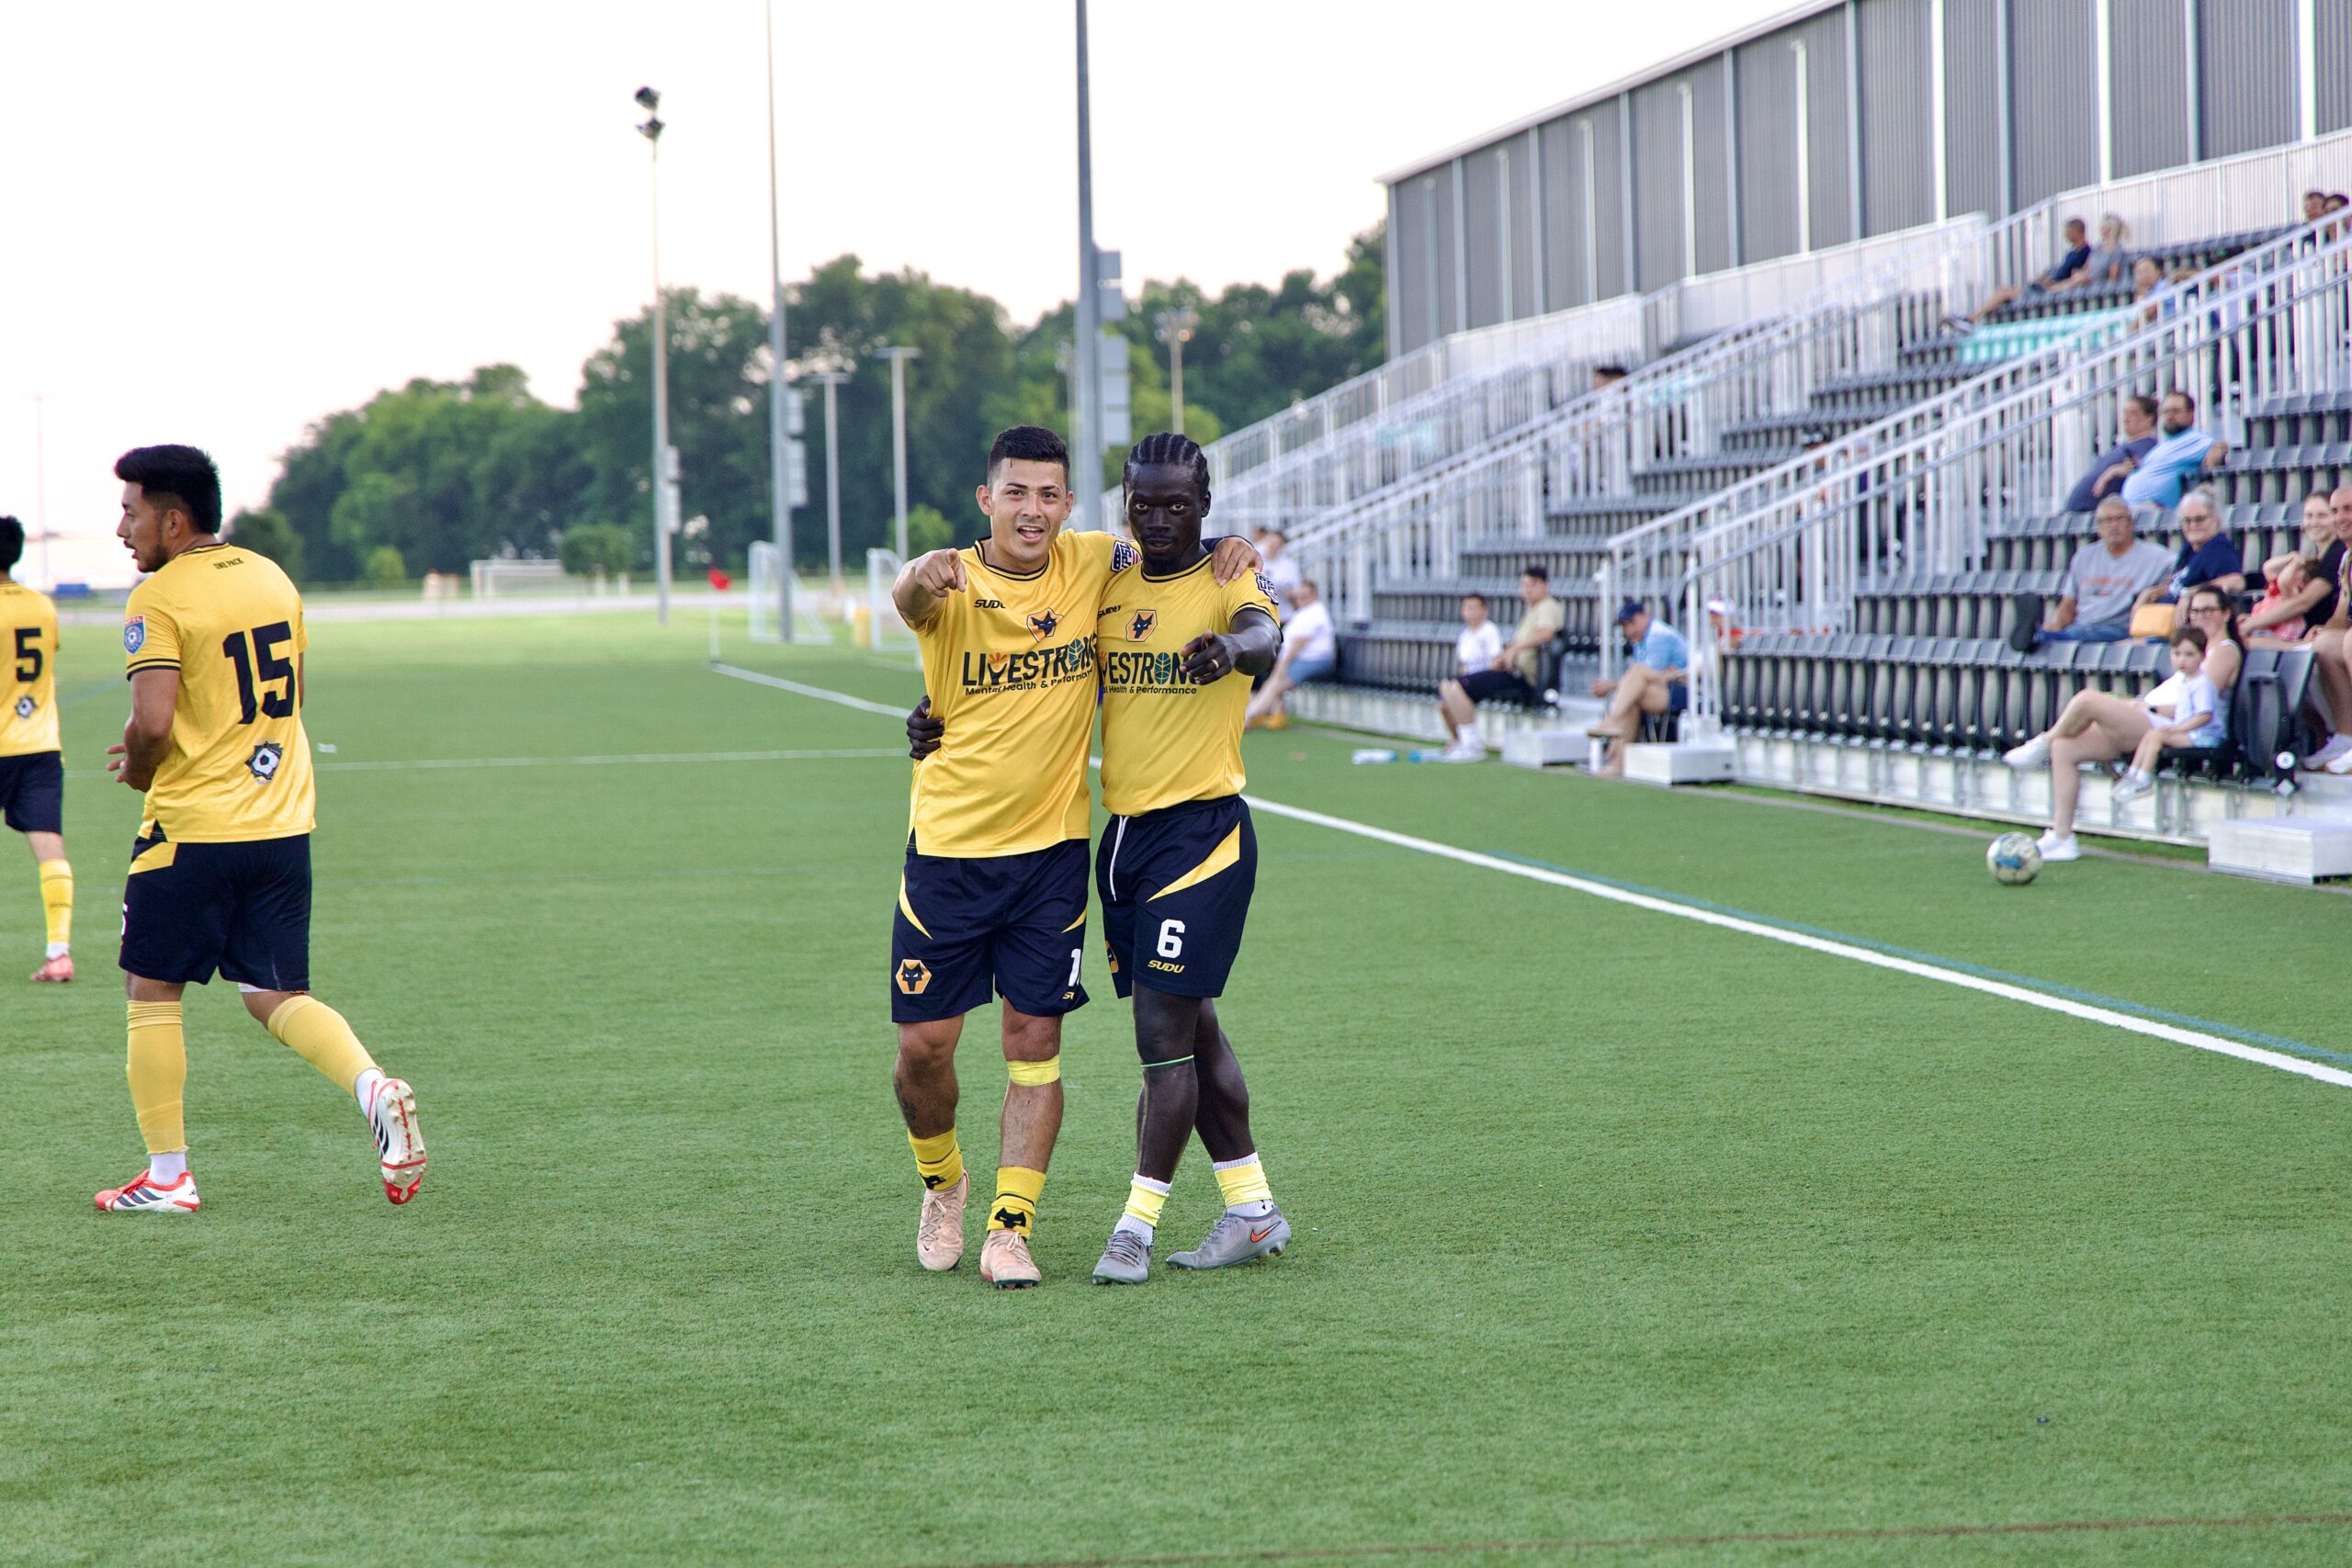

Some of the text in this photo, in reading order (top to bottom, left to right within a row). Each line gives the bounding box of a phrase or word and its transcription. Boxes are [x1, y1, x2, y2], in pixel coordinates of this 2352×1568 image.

[15, 628, 42, 682] 5
[222, 621, 295, 724] 15
[1002, 682, 1036, 691] Health
[1040, 680, 1048, 688] &
[1136, 686, 1197, 694] Performance
[1157, 919, 1185, 958] 6
[1148, 960, 1185, 974] SUDU
